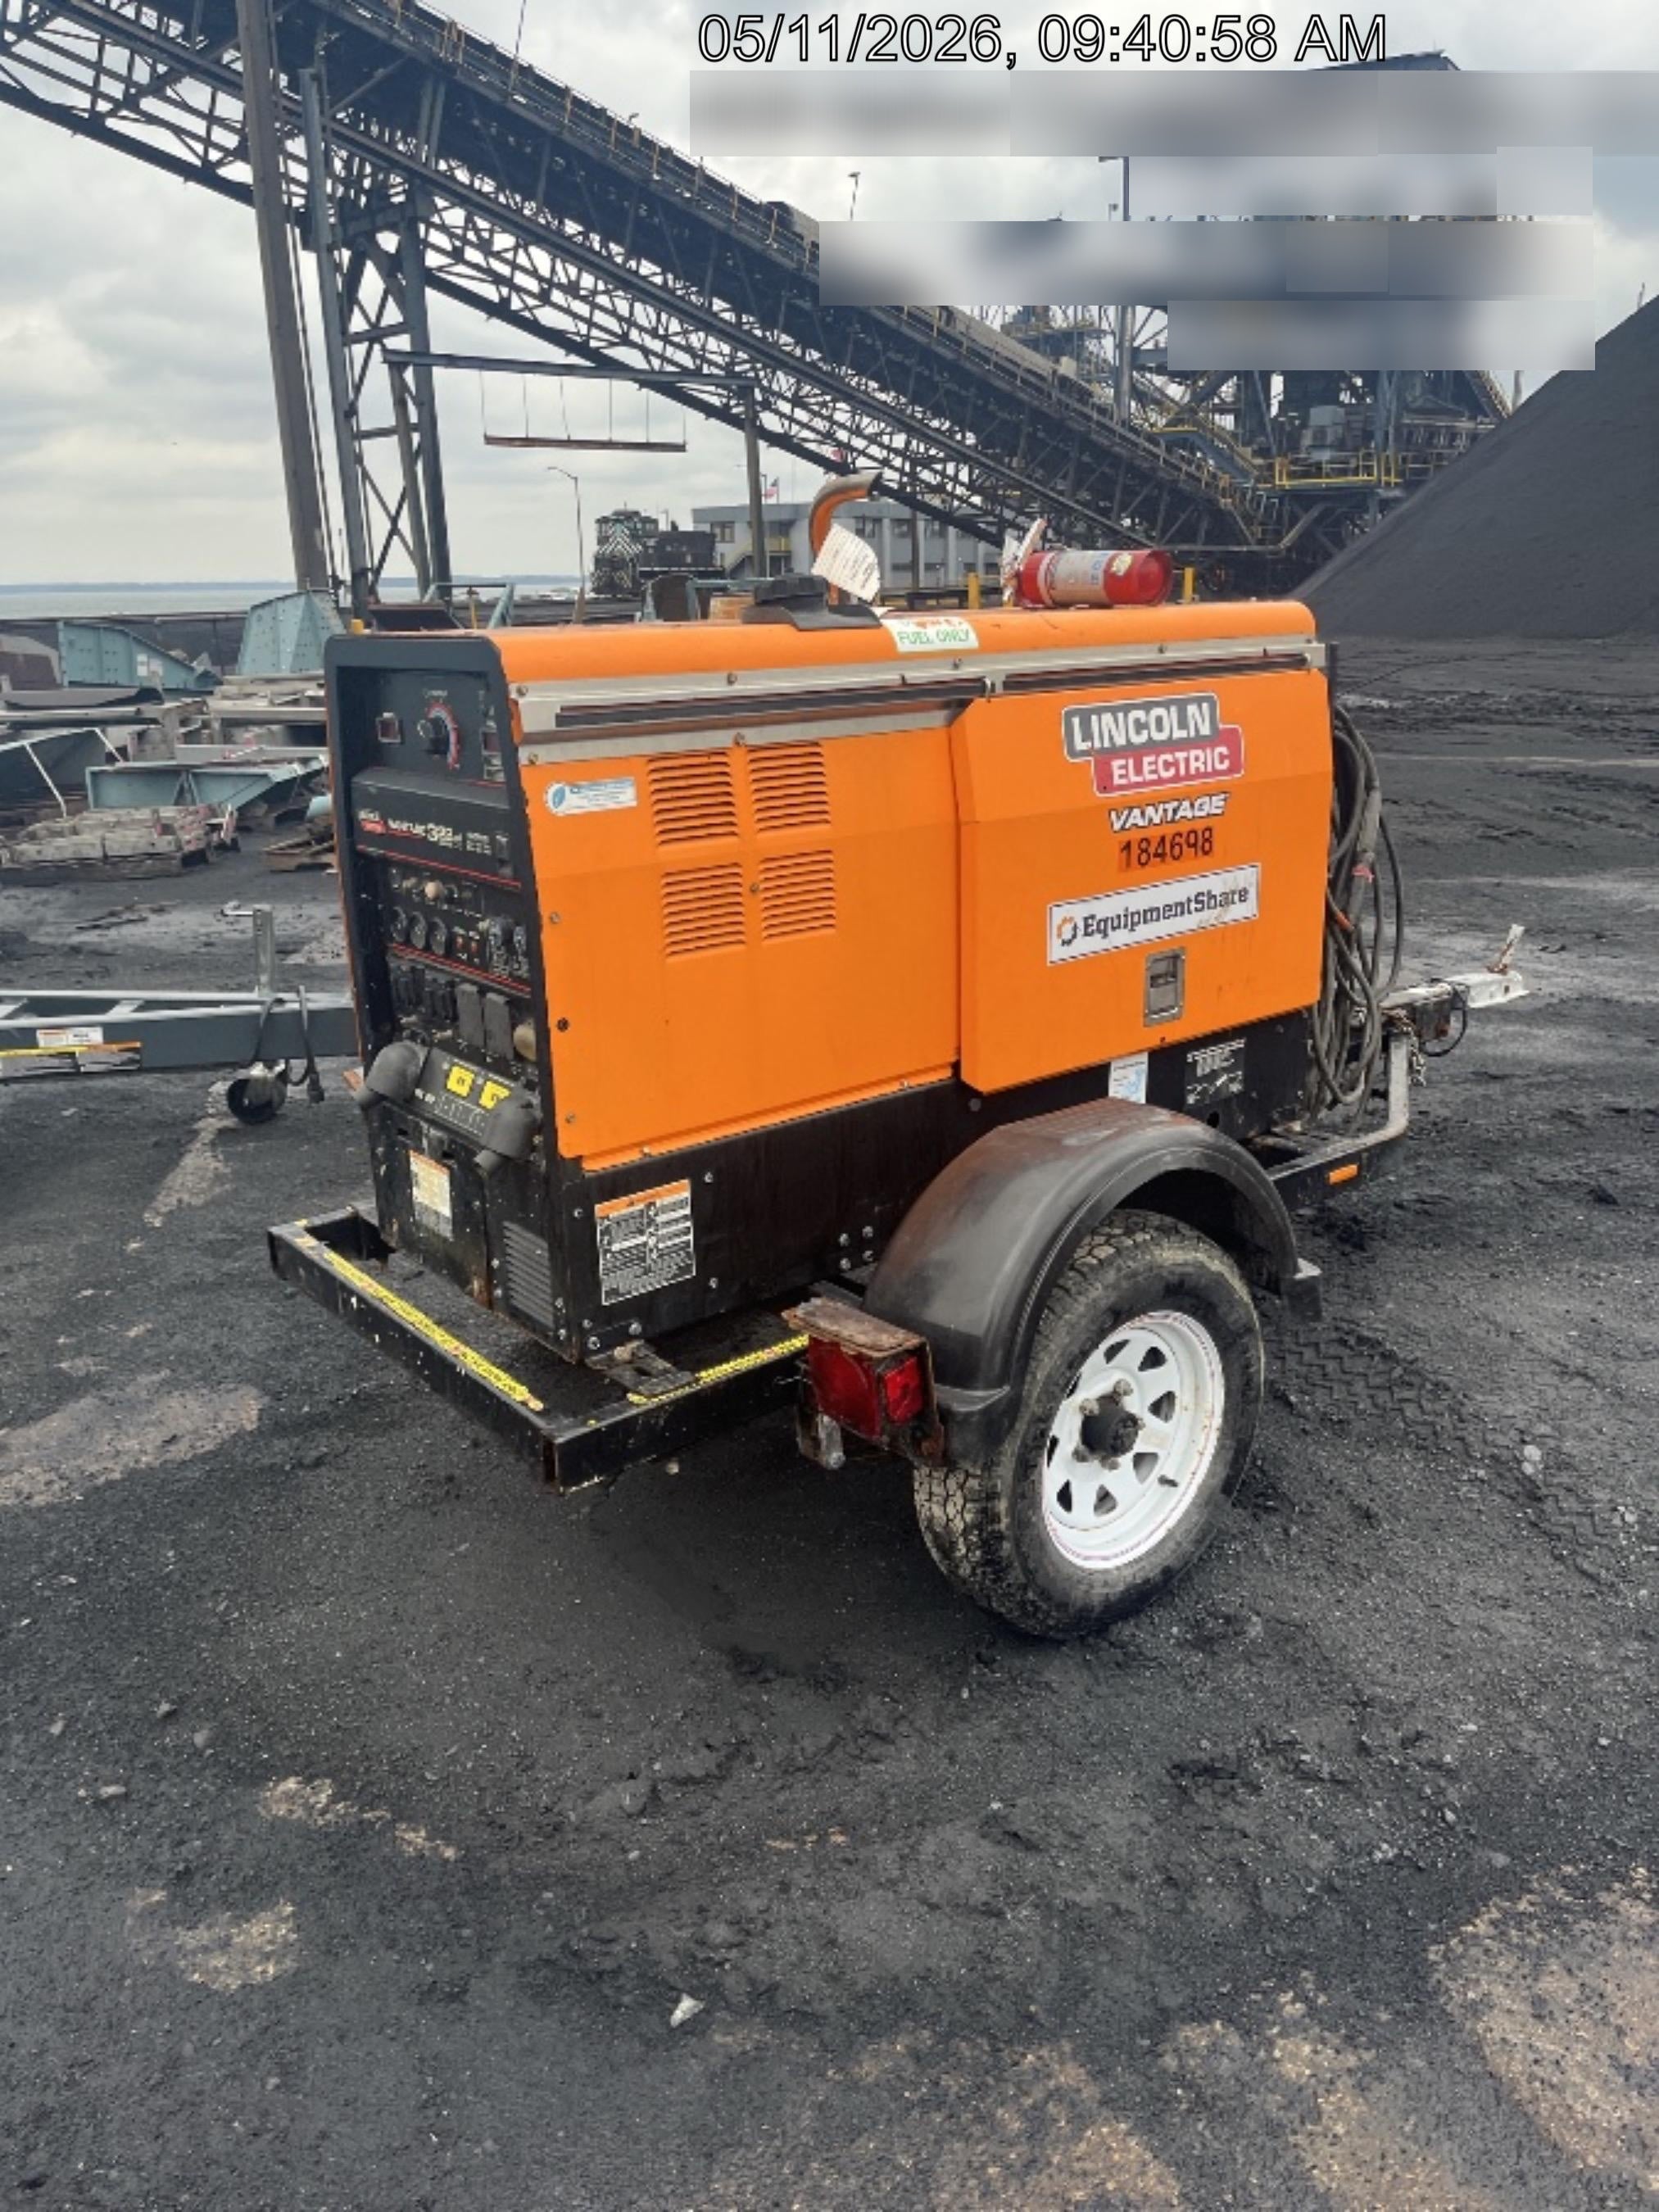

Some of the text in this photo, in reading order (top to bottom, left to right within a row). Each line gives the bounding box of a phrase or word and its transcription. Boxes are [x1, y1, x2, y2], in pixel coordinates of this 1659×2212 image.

[897, 631, 934, 646] FUEL
[1072, 703, 1211, 750] LINCOLN
[1111, 746, 1230, 786] ELECTRIC
[1110, 792, 1229, 831] VANTAGE
[1120, 827, 1213, 868] 184698
[1082, 886, 1249, 938] EquipmentShare
